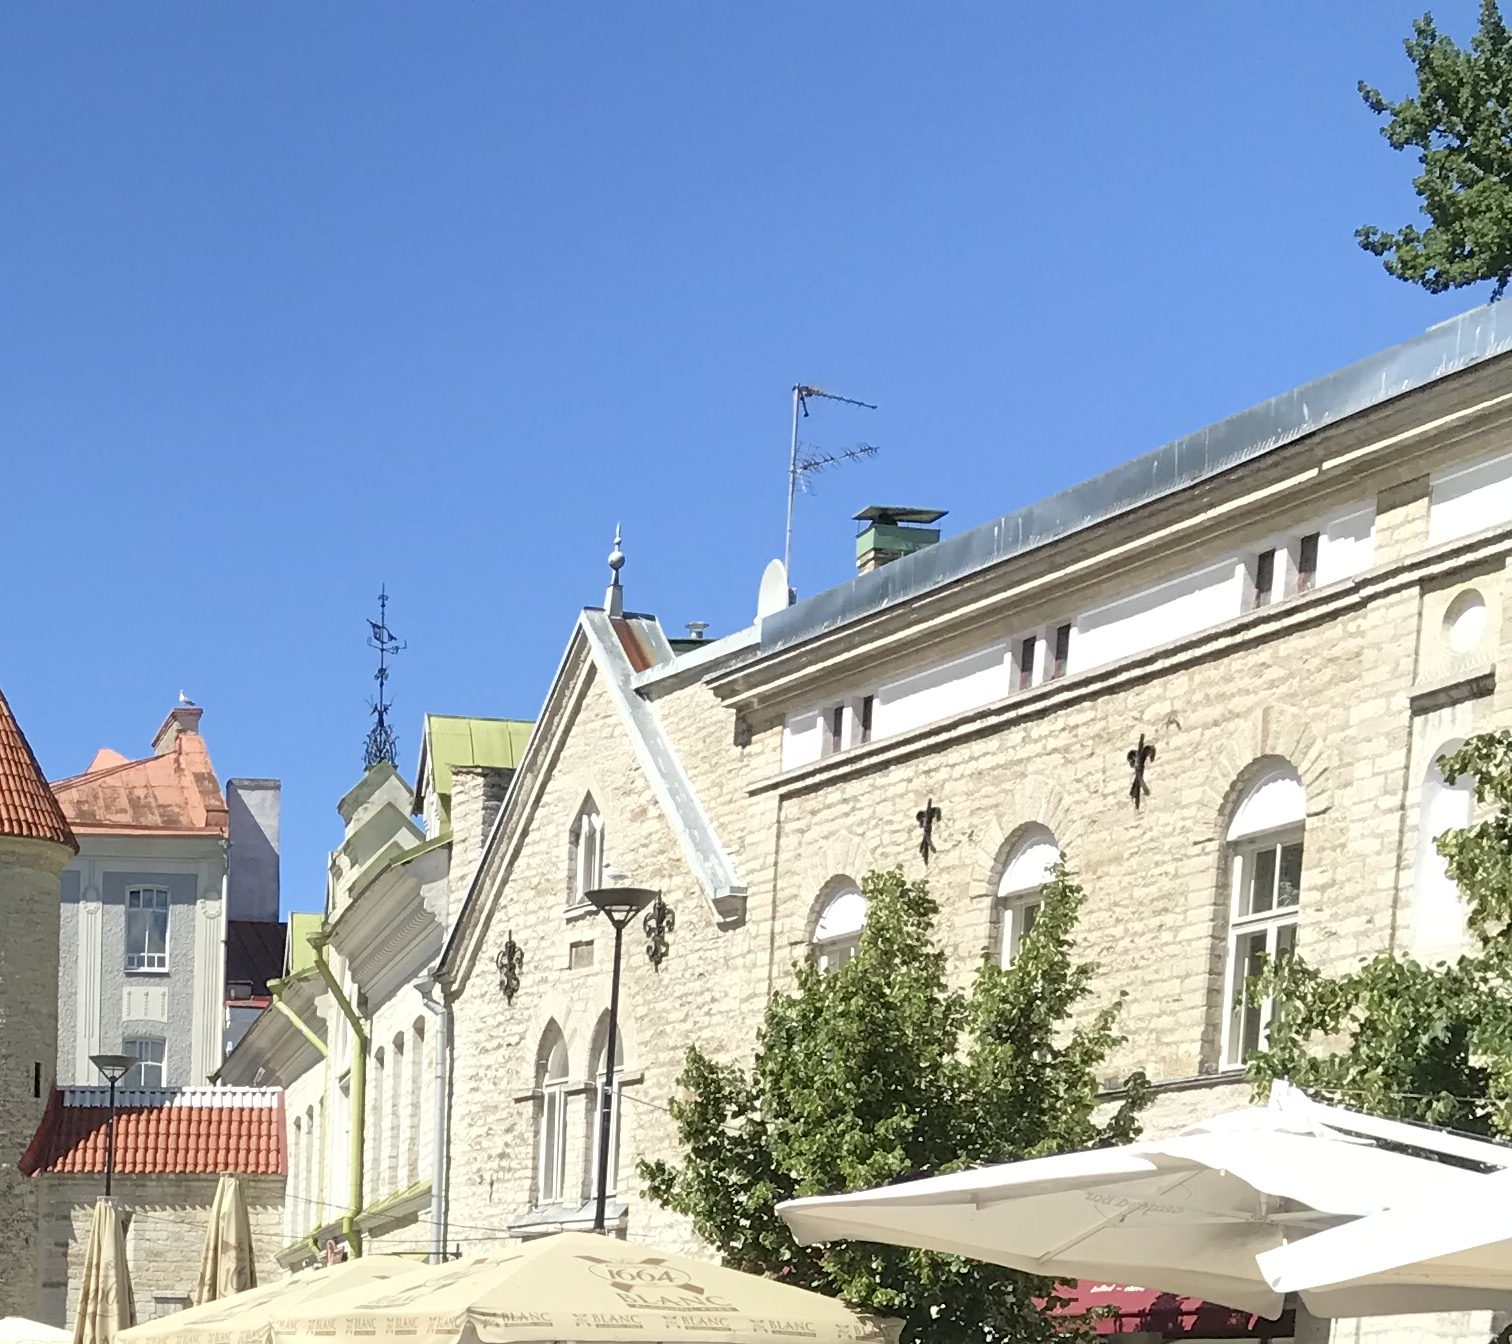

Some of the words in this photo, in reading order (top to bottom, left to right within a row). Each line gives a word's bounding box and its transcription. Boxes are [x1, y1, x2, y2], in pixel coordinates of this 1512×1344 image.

[606, 1267, 675, 1283] 1664
[616, 1292, 732, 1307] BLANC
[501, 1312, 553, 1322] BLANC
[592, 1313, 642, 1324] BLANC
[681, 1315, 730, 1326] BLANC
[769, 1320, 817, 1332] BLANC
